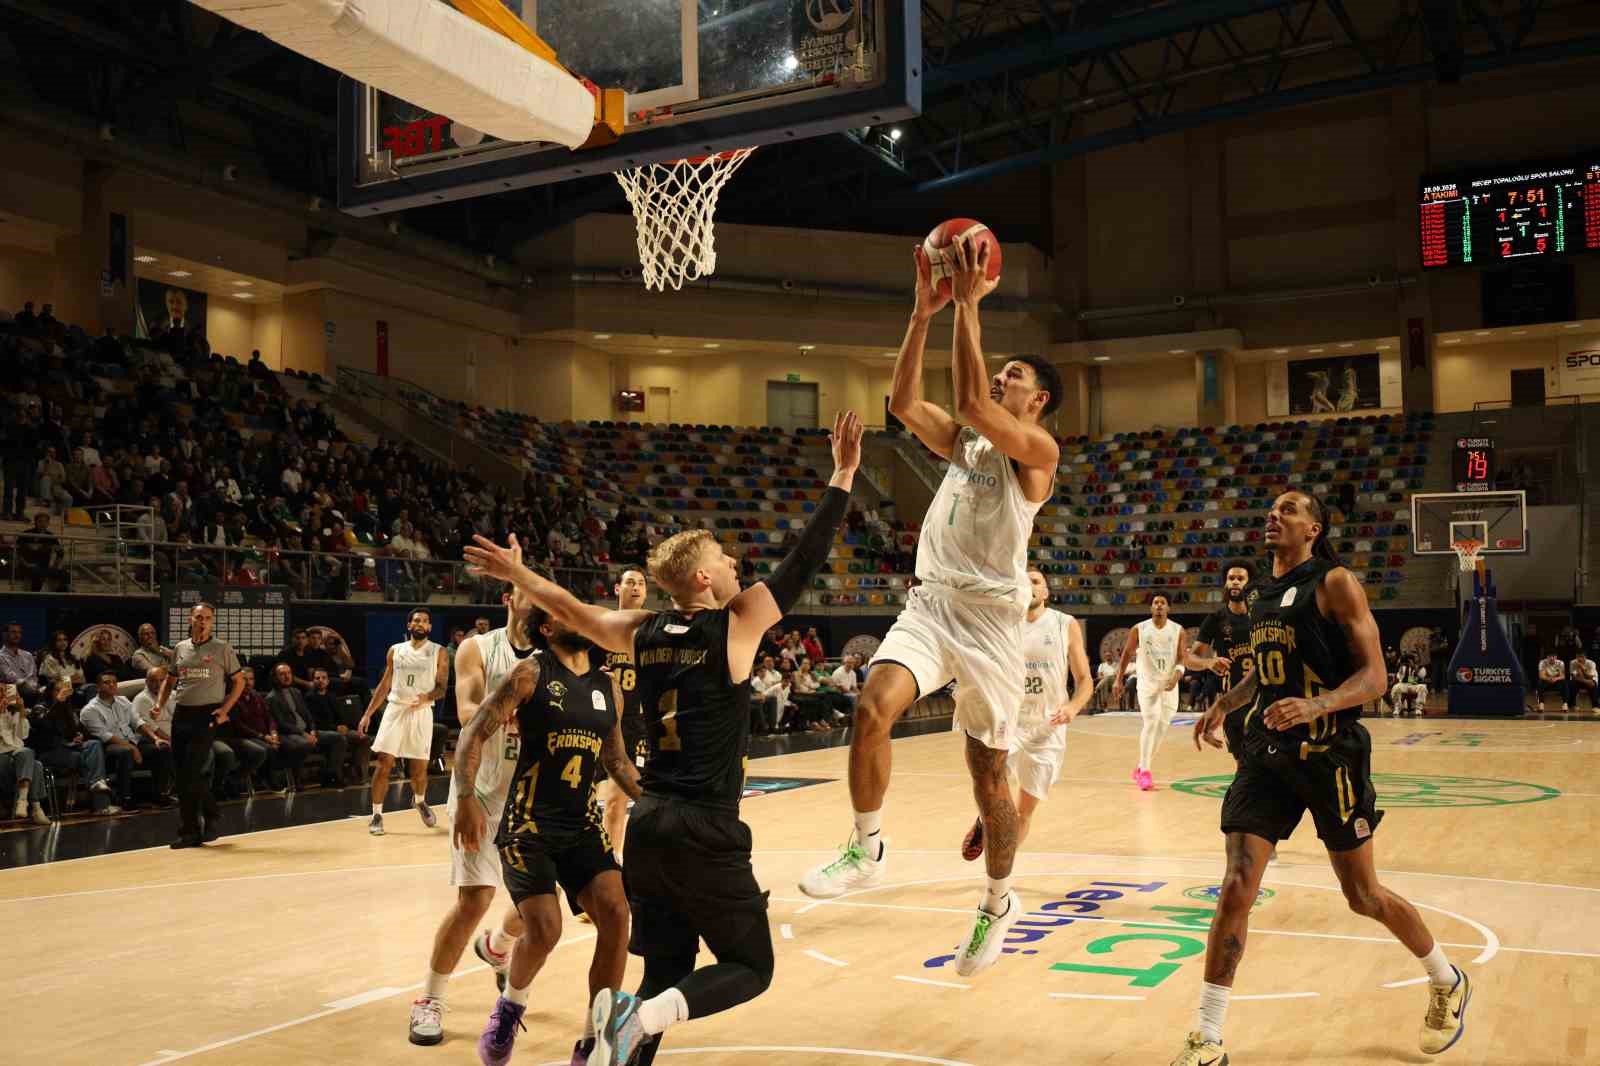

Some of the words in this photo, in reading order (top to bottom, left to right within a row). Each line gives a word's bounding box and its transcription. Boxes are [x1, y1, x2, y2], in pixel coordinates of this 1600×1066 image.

[1257, 649, 1287, 687] 10
[657, 688, 682, 752] 1
[560, 754, 583, 789] 4
